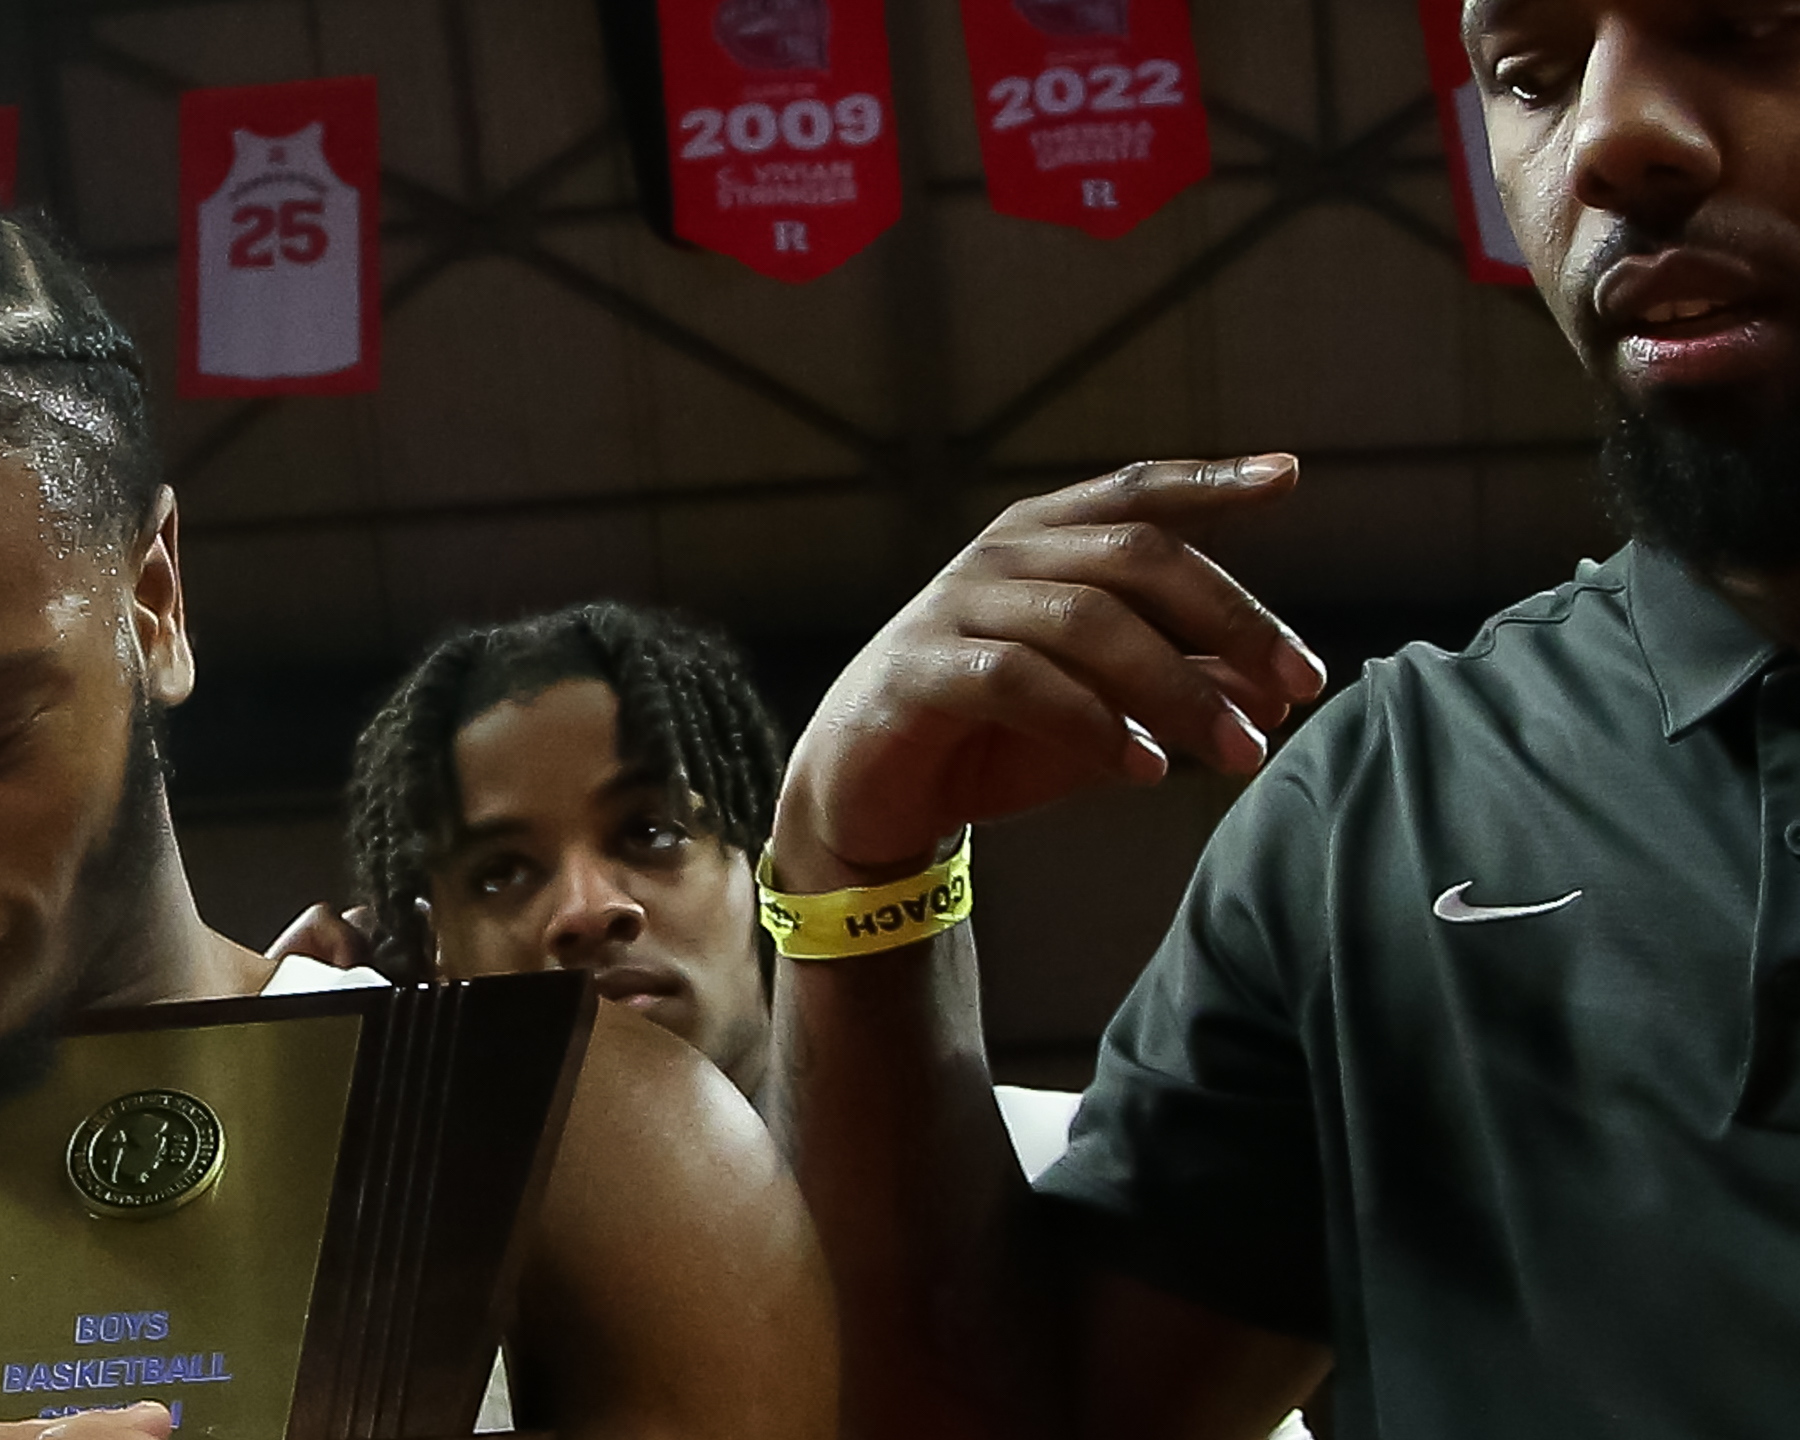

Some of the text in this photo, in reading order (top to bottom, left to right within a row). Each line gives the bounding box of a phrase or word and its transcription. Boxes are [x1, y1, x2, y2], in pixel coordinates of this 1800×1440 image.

[680, 93, 882, 160] 2009
[988, 59, 1184, 130] 2022
[229, 200, 329, 268] 25
[845, 875, 964, 938] COACH
[75, 1310, 169, 1344] BOYS
[3, 1352, 232, 1393] BASKETBALL
